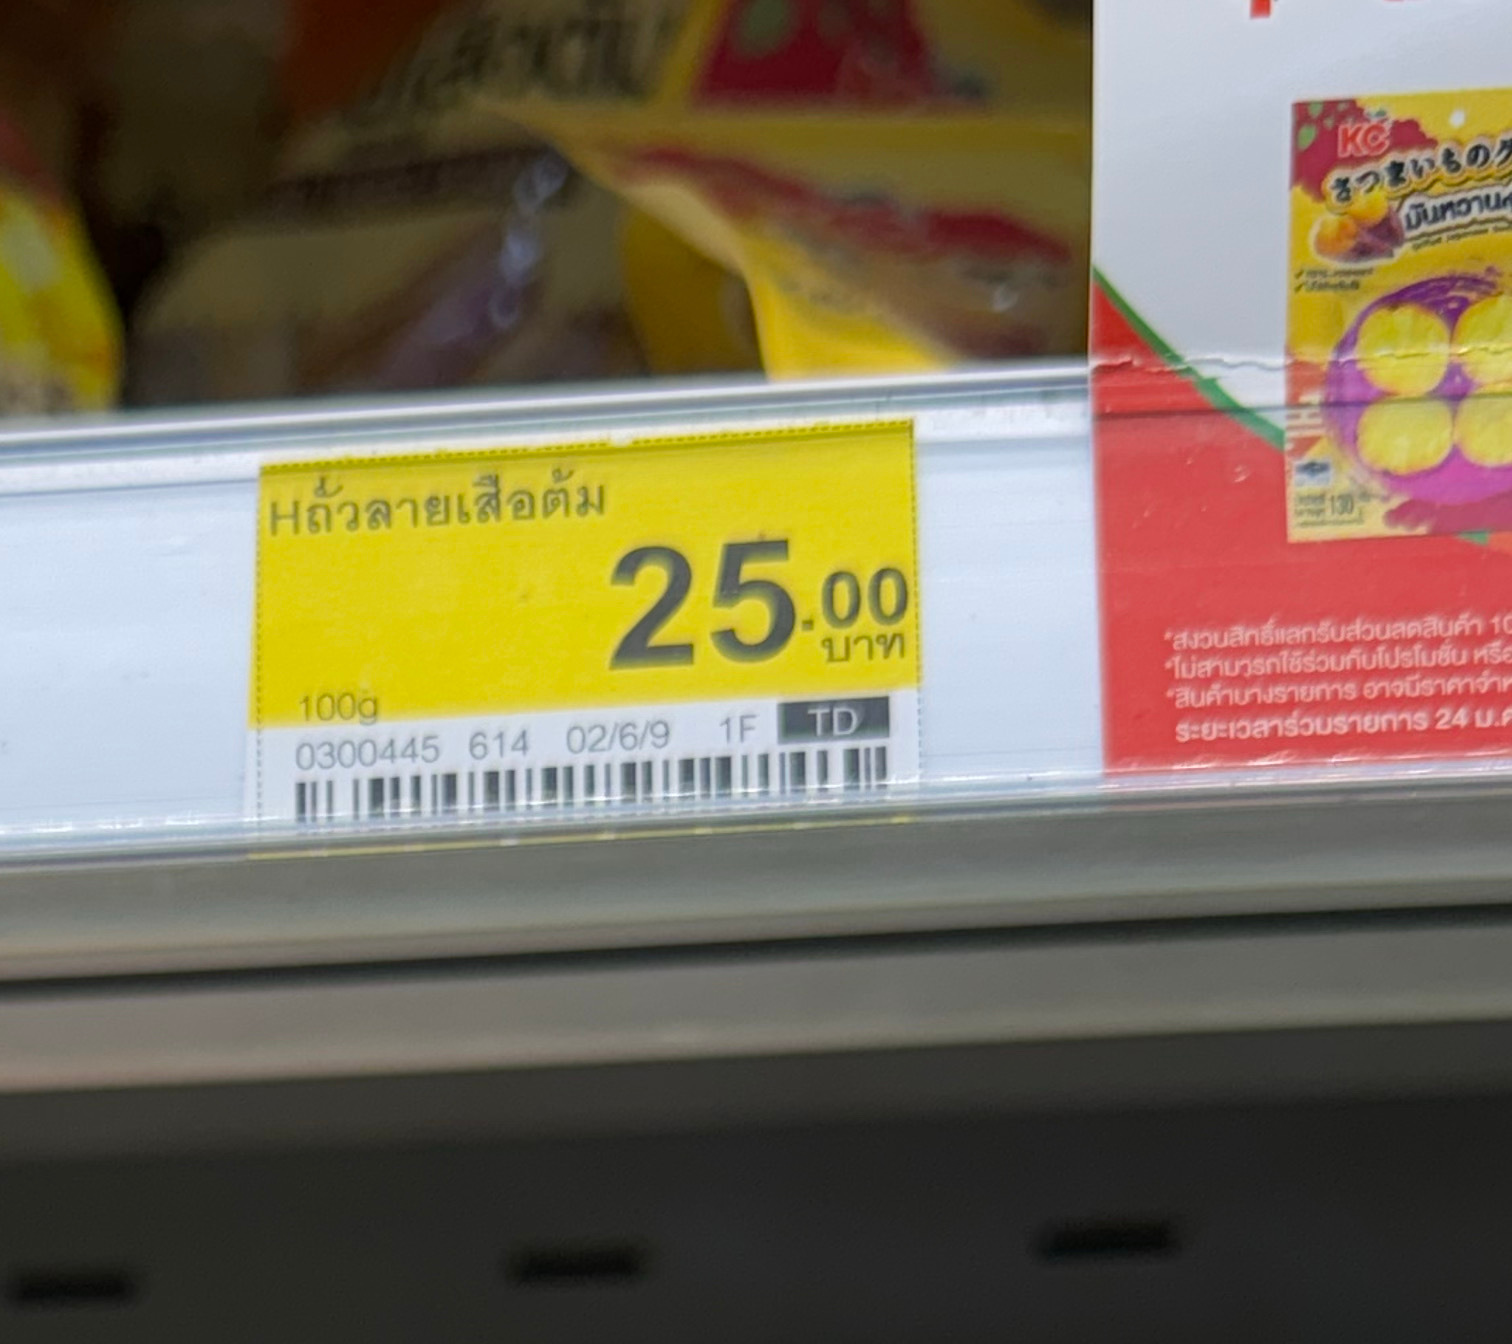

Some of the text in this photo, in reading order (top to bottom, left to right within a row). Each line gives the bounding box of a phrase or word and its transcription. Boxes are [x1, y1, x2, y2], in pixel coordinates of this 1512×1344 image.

[1340, 122, 1391, 158] KC
[269, 466, 605, 536] Hถั่วลายเสือต้ม
[821, 632, 906, 664] บาท
[299, 692, 380, 725] 100g
[1434, 706, 1468, 731] 24
[295, 706, 859, 772] 0300445 614 02/6/9 1F TD
